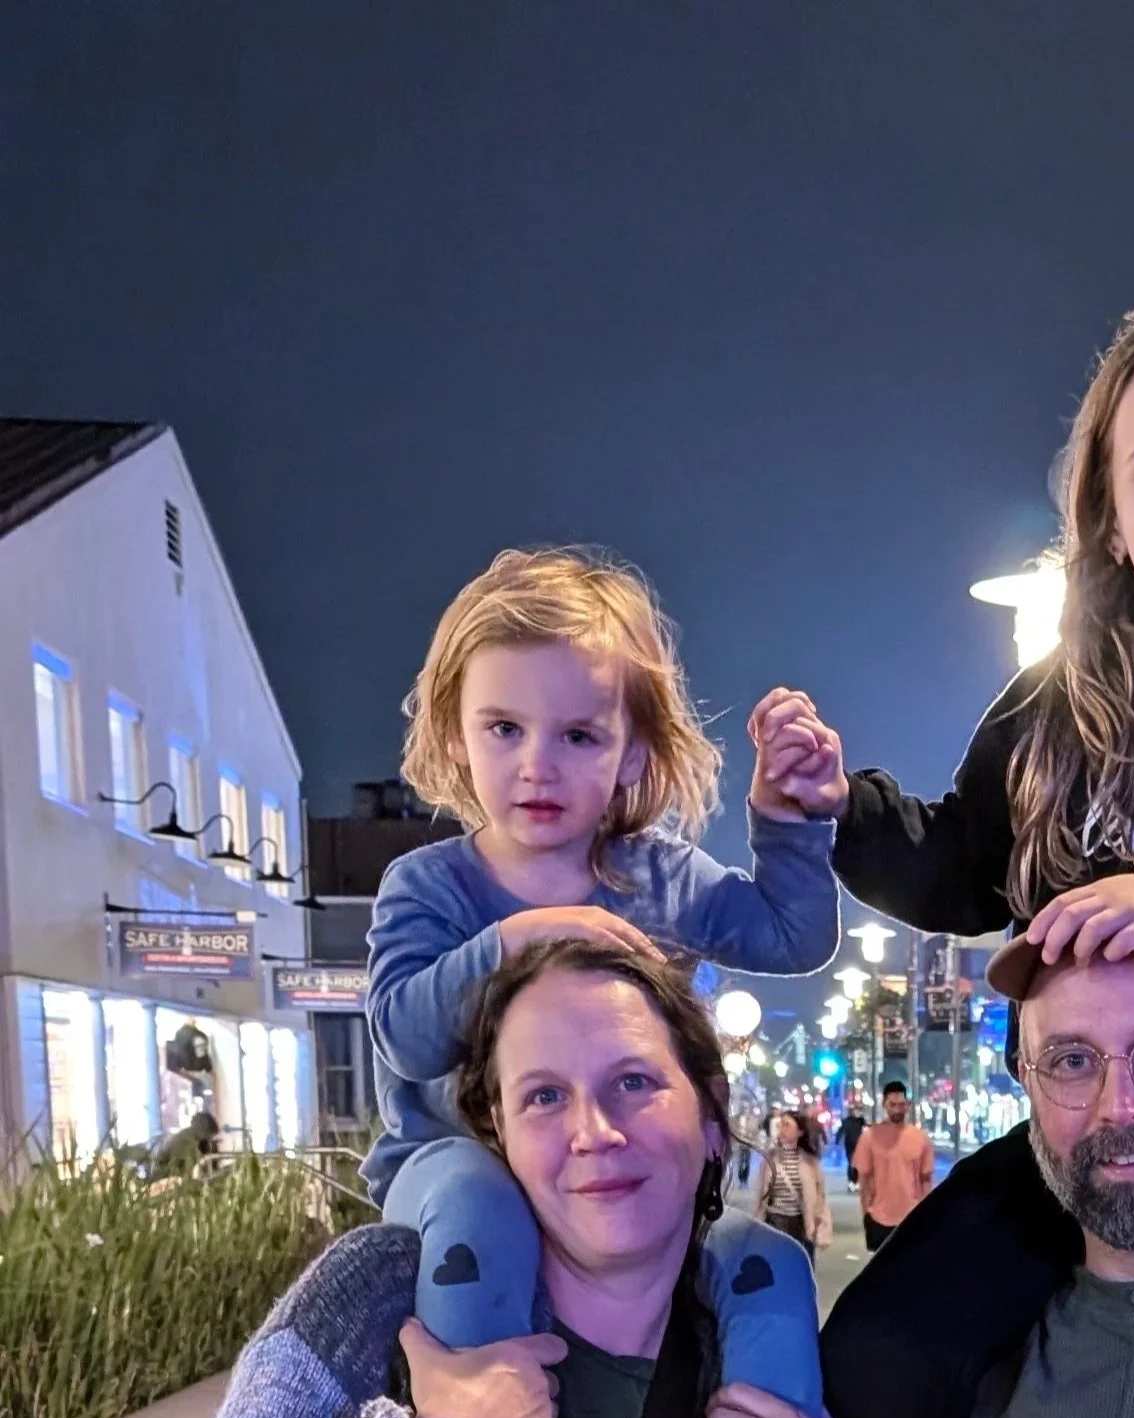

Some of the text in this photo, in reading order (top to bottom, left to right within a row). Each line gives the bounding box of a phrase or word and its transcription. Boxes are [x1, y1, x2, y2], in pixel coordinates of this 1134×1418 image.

[125, 930, 249, 952] SAFE HARBOR
[277, 973, 312, 989] SAFE
